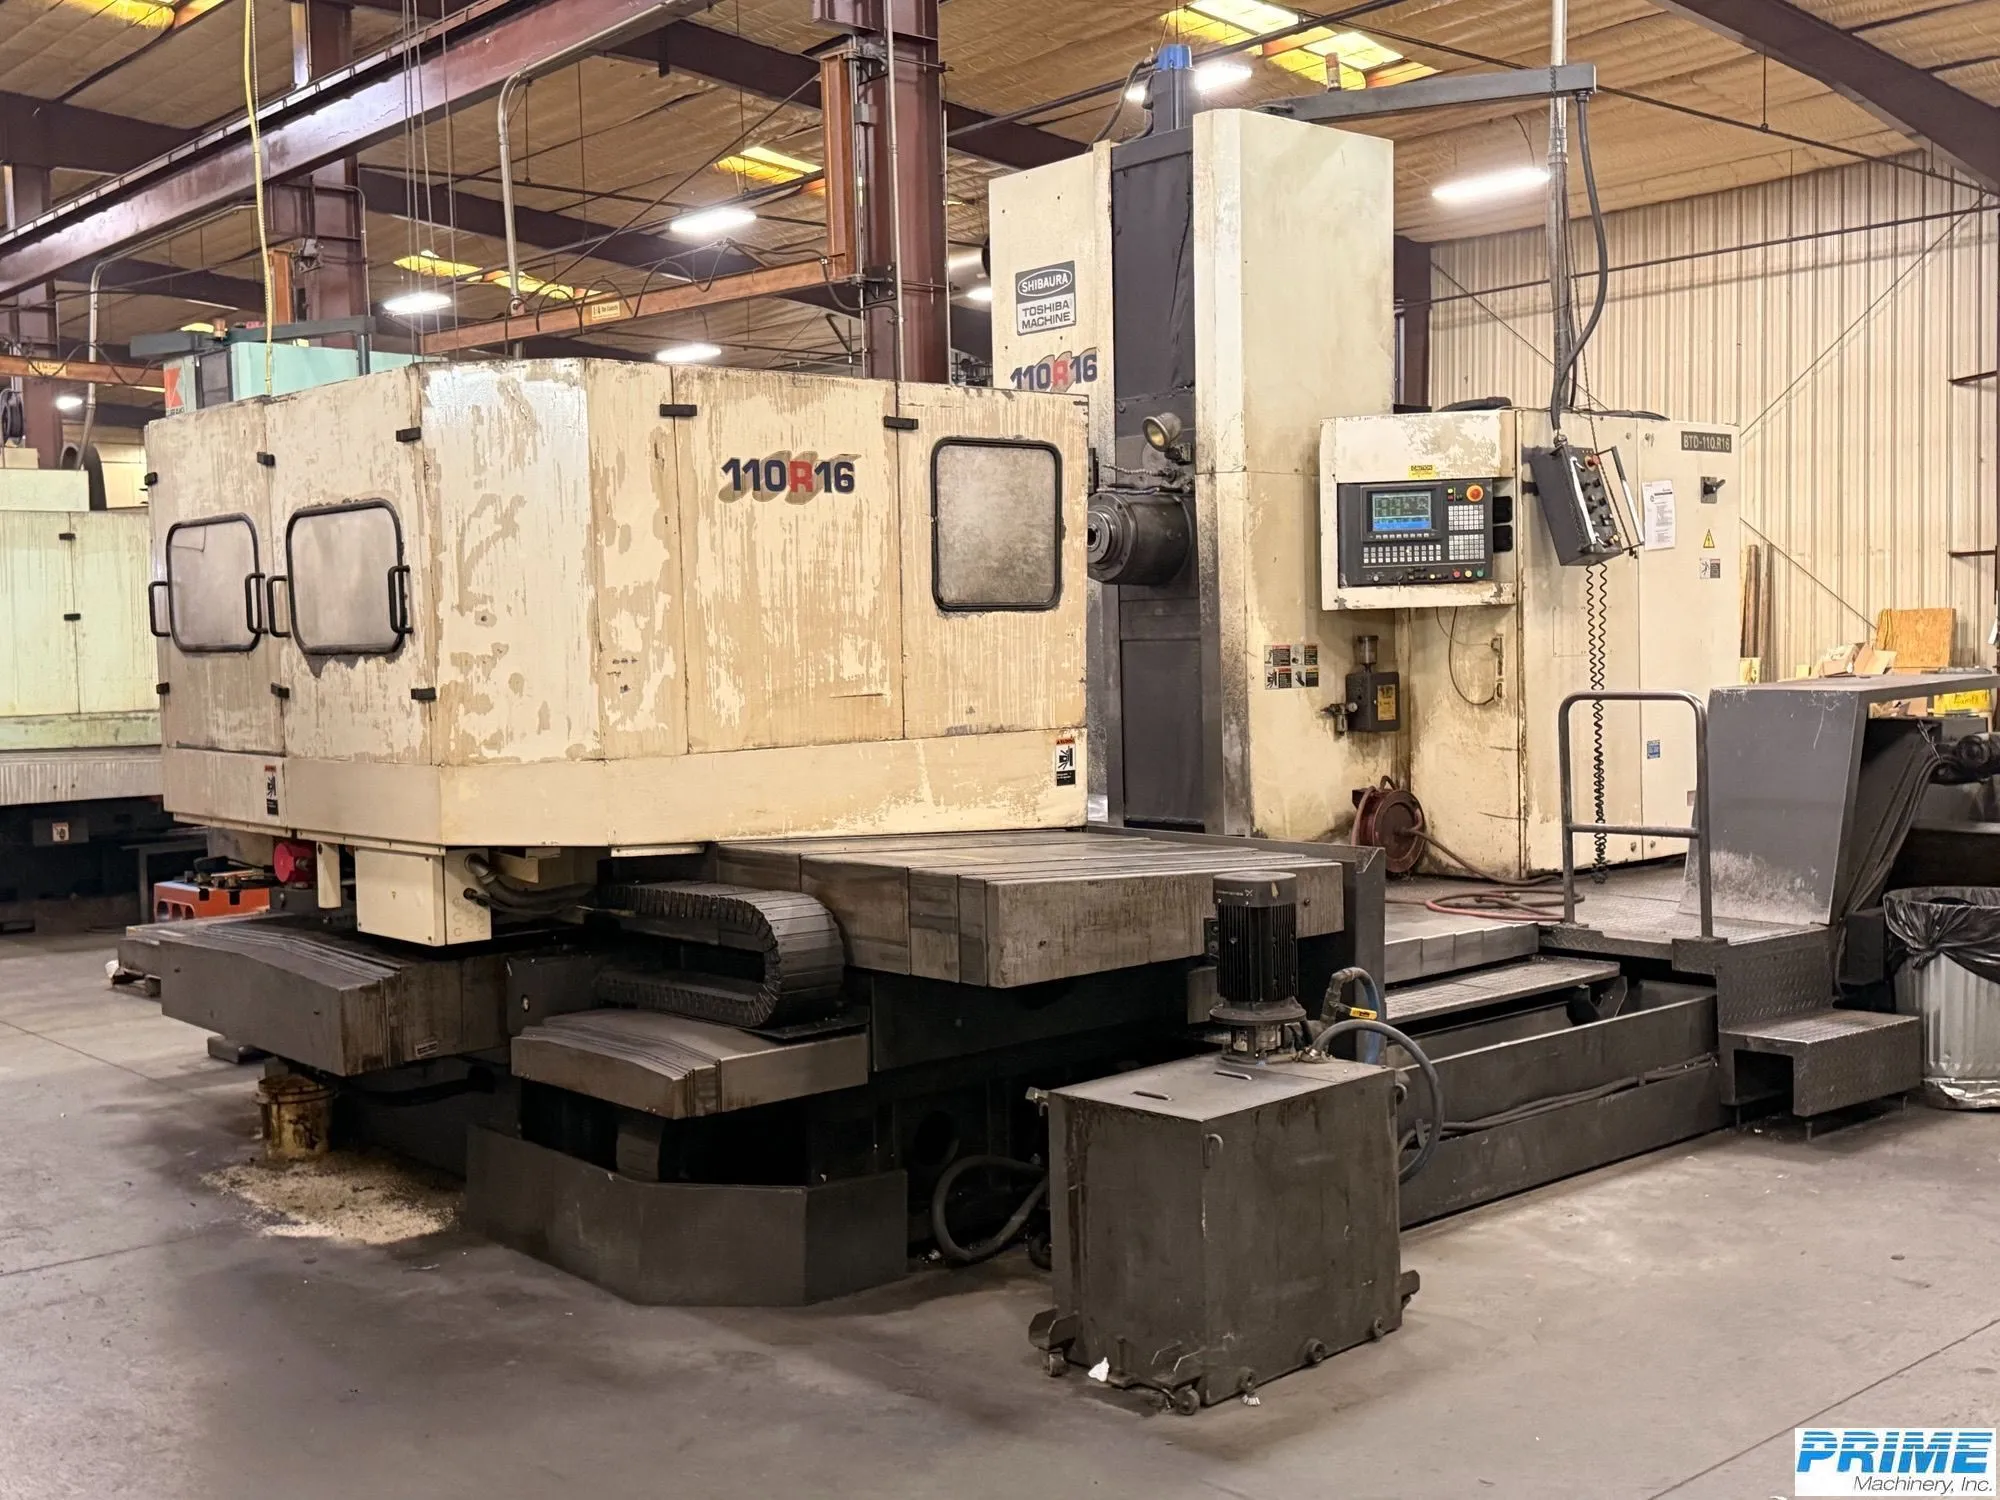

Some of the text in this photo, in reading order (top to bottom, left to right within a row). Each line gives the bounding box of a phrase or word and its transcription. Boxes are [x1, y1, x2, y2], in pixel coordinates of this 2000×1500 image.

[1021, 272, 1069, 293] SHIBAURA
[1022, 300, 1070, 317] TOSHIBA
[1021, 312, 1071, 329] MACHINE
[1010, 354, 1097, 390] 110R16
[721, 457, 855, 494] 110R16
